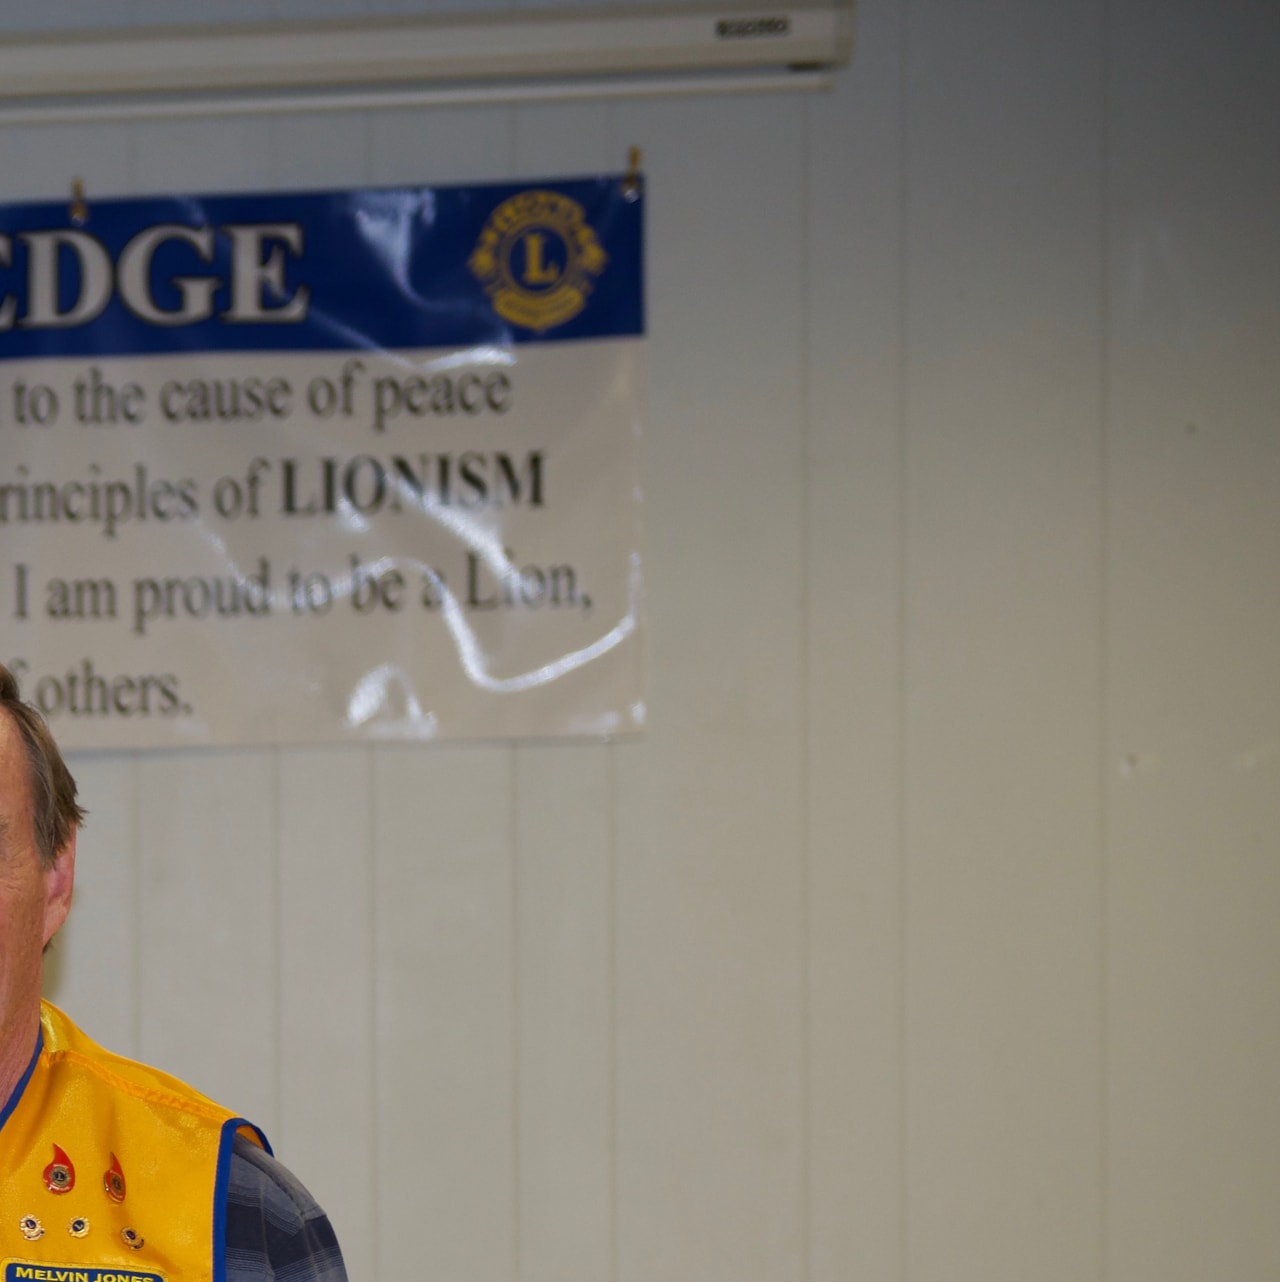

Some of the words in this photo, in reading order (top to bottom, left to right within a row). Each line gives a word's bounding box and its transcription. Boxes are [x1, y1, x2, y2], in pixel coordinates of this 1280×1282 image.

[11, 376, 60, 426] to
[72, 367, 148, 424] the
[159, 375, 293, 422] cause
[307, 362, 370, 418] of
[374, 369, 513, 432] peace
[214, 464, 274, 519] of
[278, 451, 547, 518] LIONISM
[11, 564, 31, 622] I
[45, 577, 117, 621] am
[132, 560, 273, 631] proud
[285, 557, 333, 613] to
[349, 553, 407, 612] be
[418, 568, 448, 608] a
[463, 550, 593, 613] Lion,
[41, 664, 192, 720] others.
[15, 1266, 89, 1282] MELVIN
